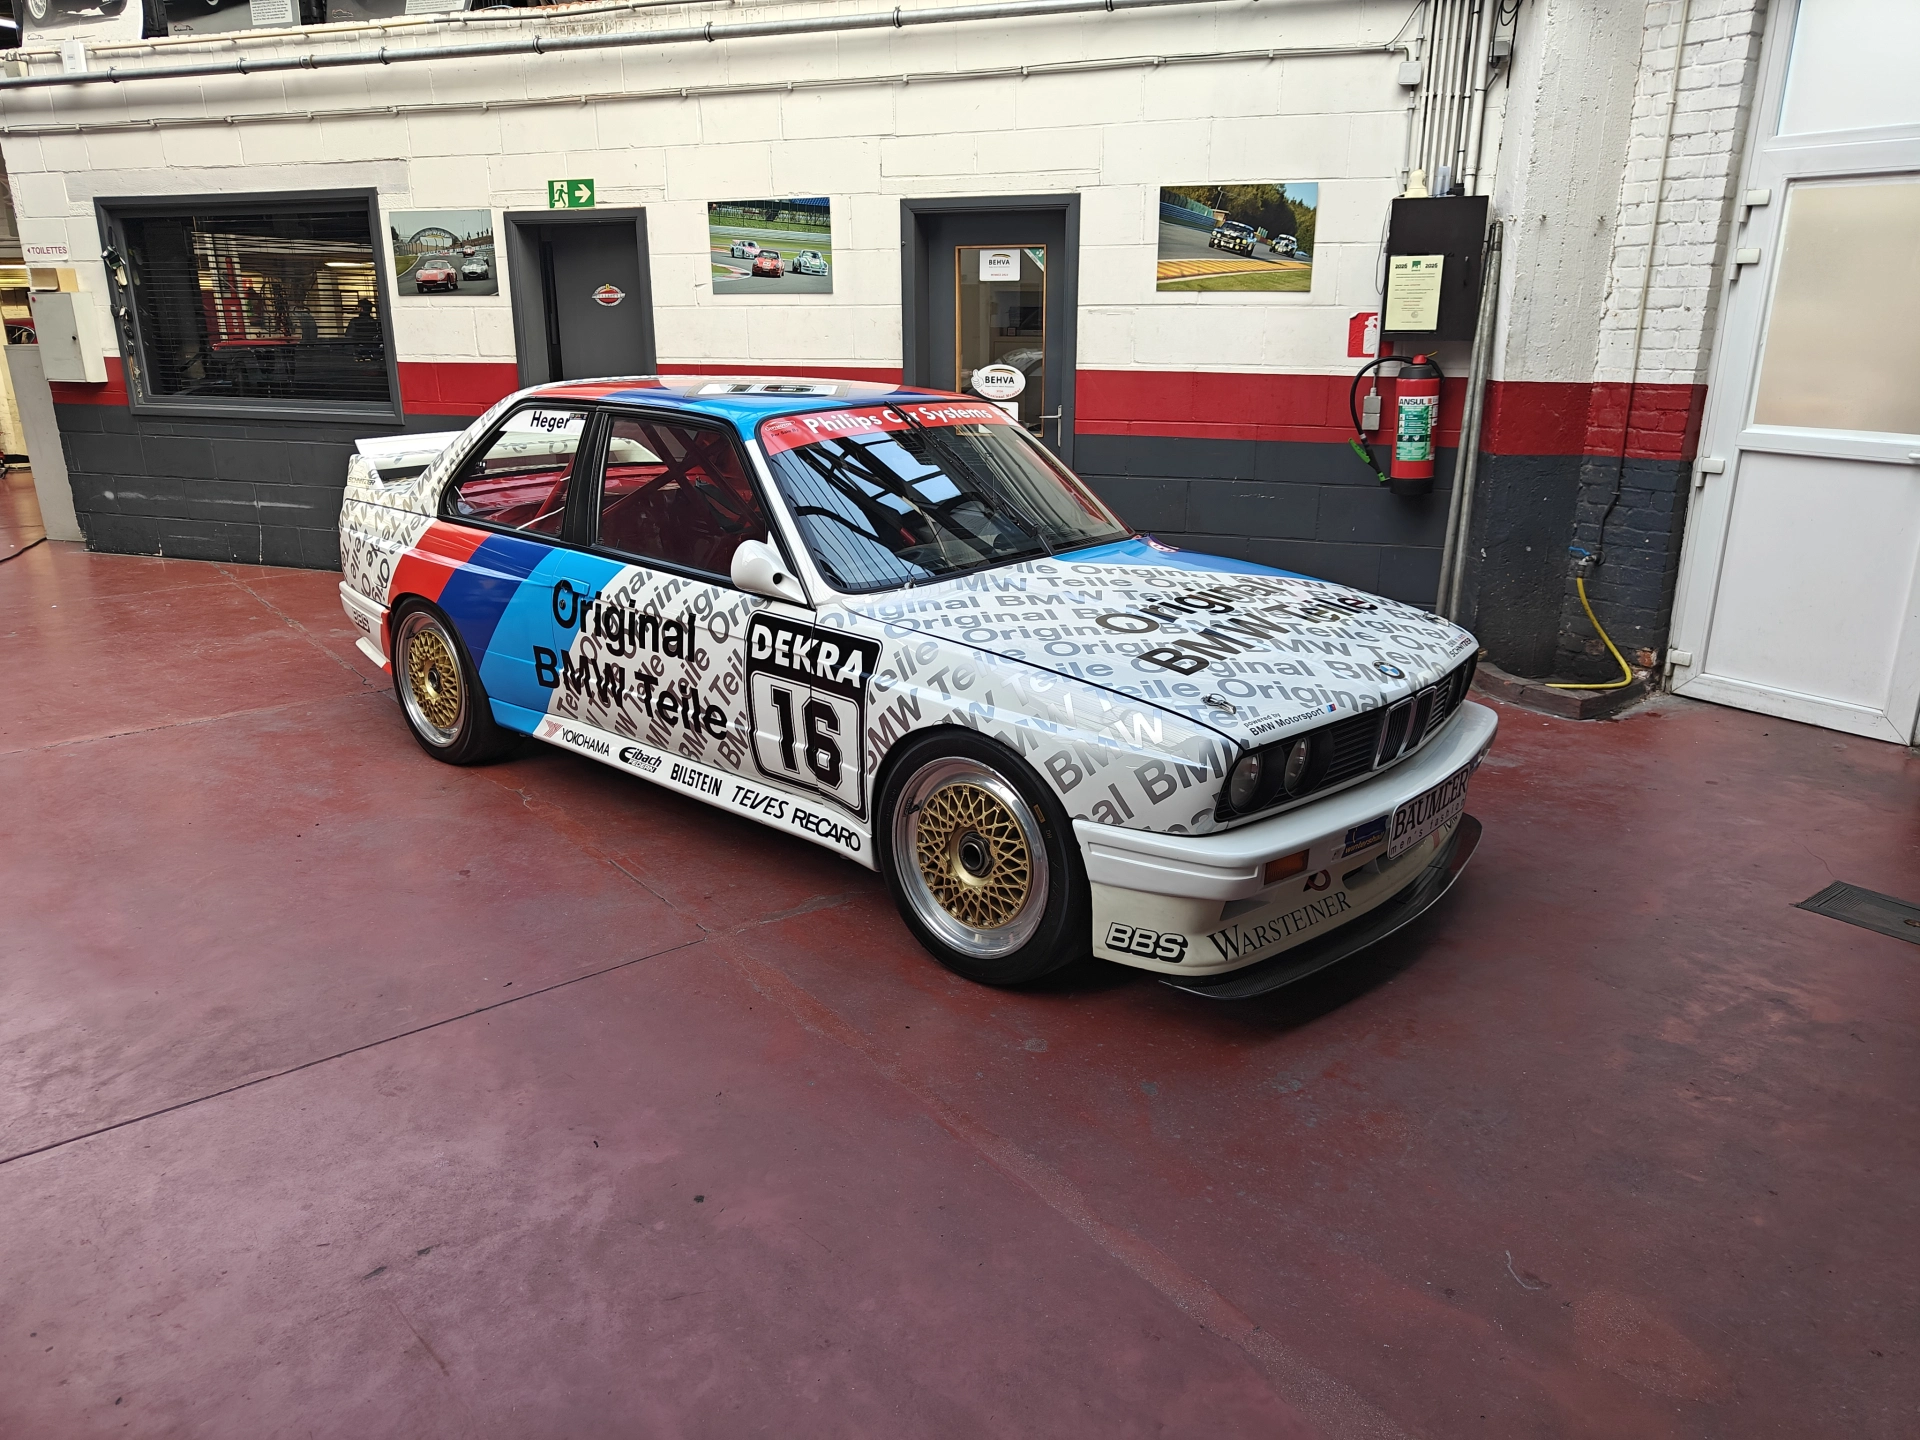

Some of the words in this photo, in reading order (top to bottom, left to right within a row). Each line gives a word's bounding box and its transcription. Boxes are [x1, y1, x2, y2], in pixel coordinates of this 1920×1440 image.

[31, 246, 68, 254] TOILETTES
[984, 375, 1015, 385] BEHVA
[1399, 398, 1427, 406] ANSUL
[530, 410, 571, 432] Heger
[803, 413, 883, 434] Philips
[882, 409, 920, 424] Cr
[918, 407, 993, 423] Systems
[995, 590, 1103, 607] BMW
[1095, 575, 1288, 635] Original
[553, 579, 697, 662] Original
[1137, 612, 1291, 676] BMW
[1260, 597, 1378, 624] Teile
[751, 623, 863, 688] DEKRA
[531, 645, 626, 708] BMW
[634, 671, 728, 740] Teile
[1244, 714, 1273, 727] powered
[1273, 711, 1282, 721] by
[1249, 722, 1276, 736] BMW
[1276, 707, 1324, 728] Motorsport
[560, 727, 612, 756] YOKOHAMA
[770, 684, 843, 790] 16
[618, 746, 662, 768] Eibach
[670, 763, 723, 796] BILSTEIN
[731, 785, 790, 820] TEVES
[791, 807, 862, 852] RECARO
[1206, 890, 1352, 962] WARSTEINER
[1105, 921, 1189, 964] BBS
